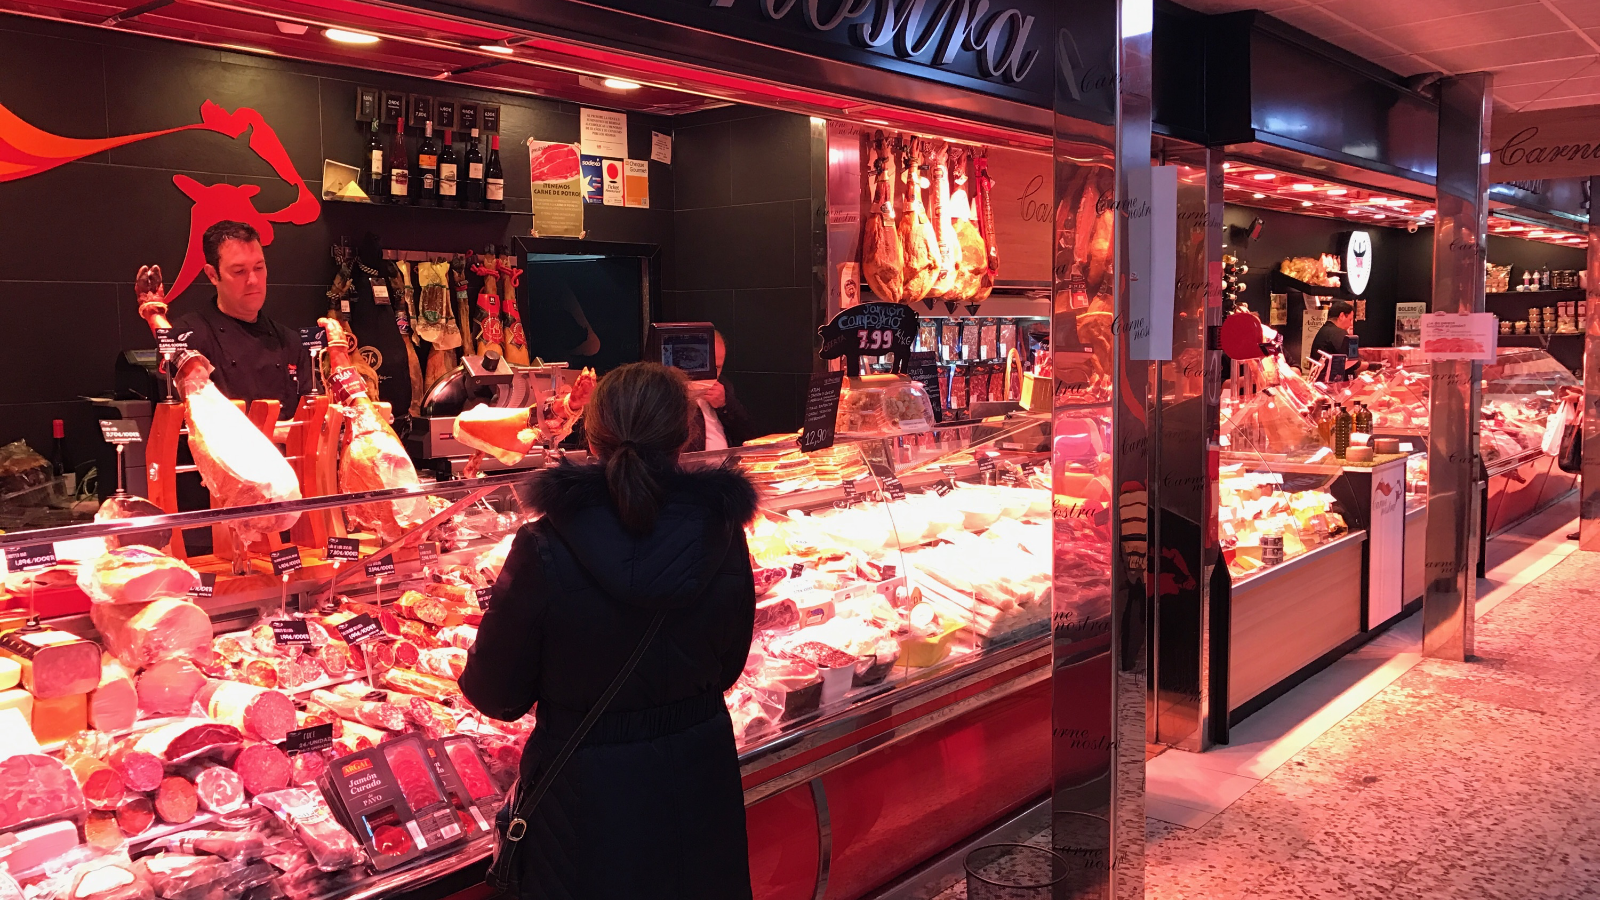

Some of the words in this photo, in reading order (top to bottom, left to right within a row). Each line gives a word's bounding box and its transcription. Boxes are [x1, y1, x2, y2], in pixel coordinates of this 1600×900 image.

[629, 160, 645, 168] Cheque
[823, 334, 847, 353] OFERTA
[857, 329, 893, 351] 7,99
[343, 761, 371, 775] ARGAL
[348, 773, 378, 788] Jamón
[350, 779, 382, 795] Curado
[362, 795, 383, 806] PAVO
